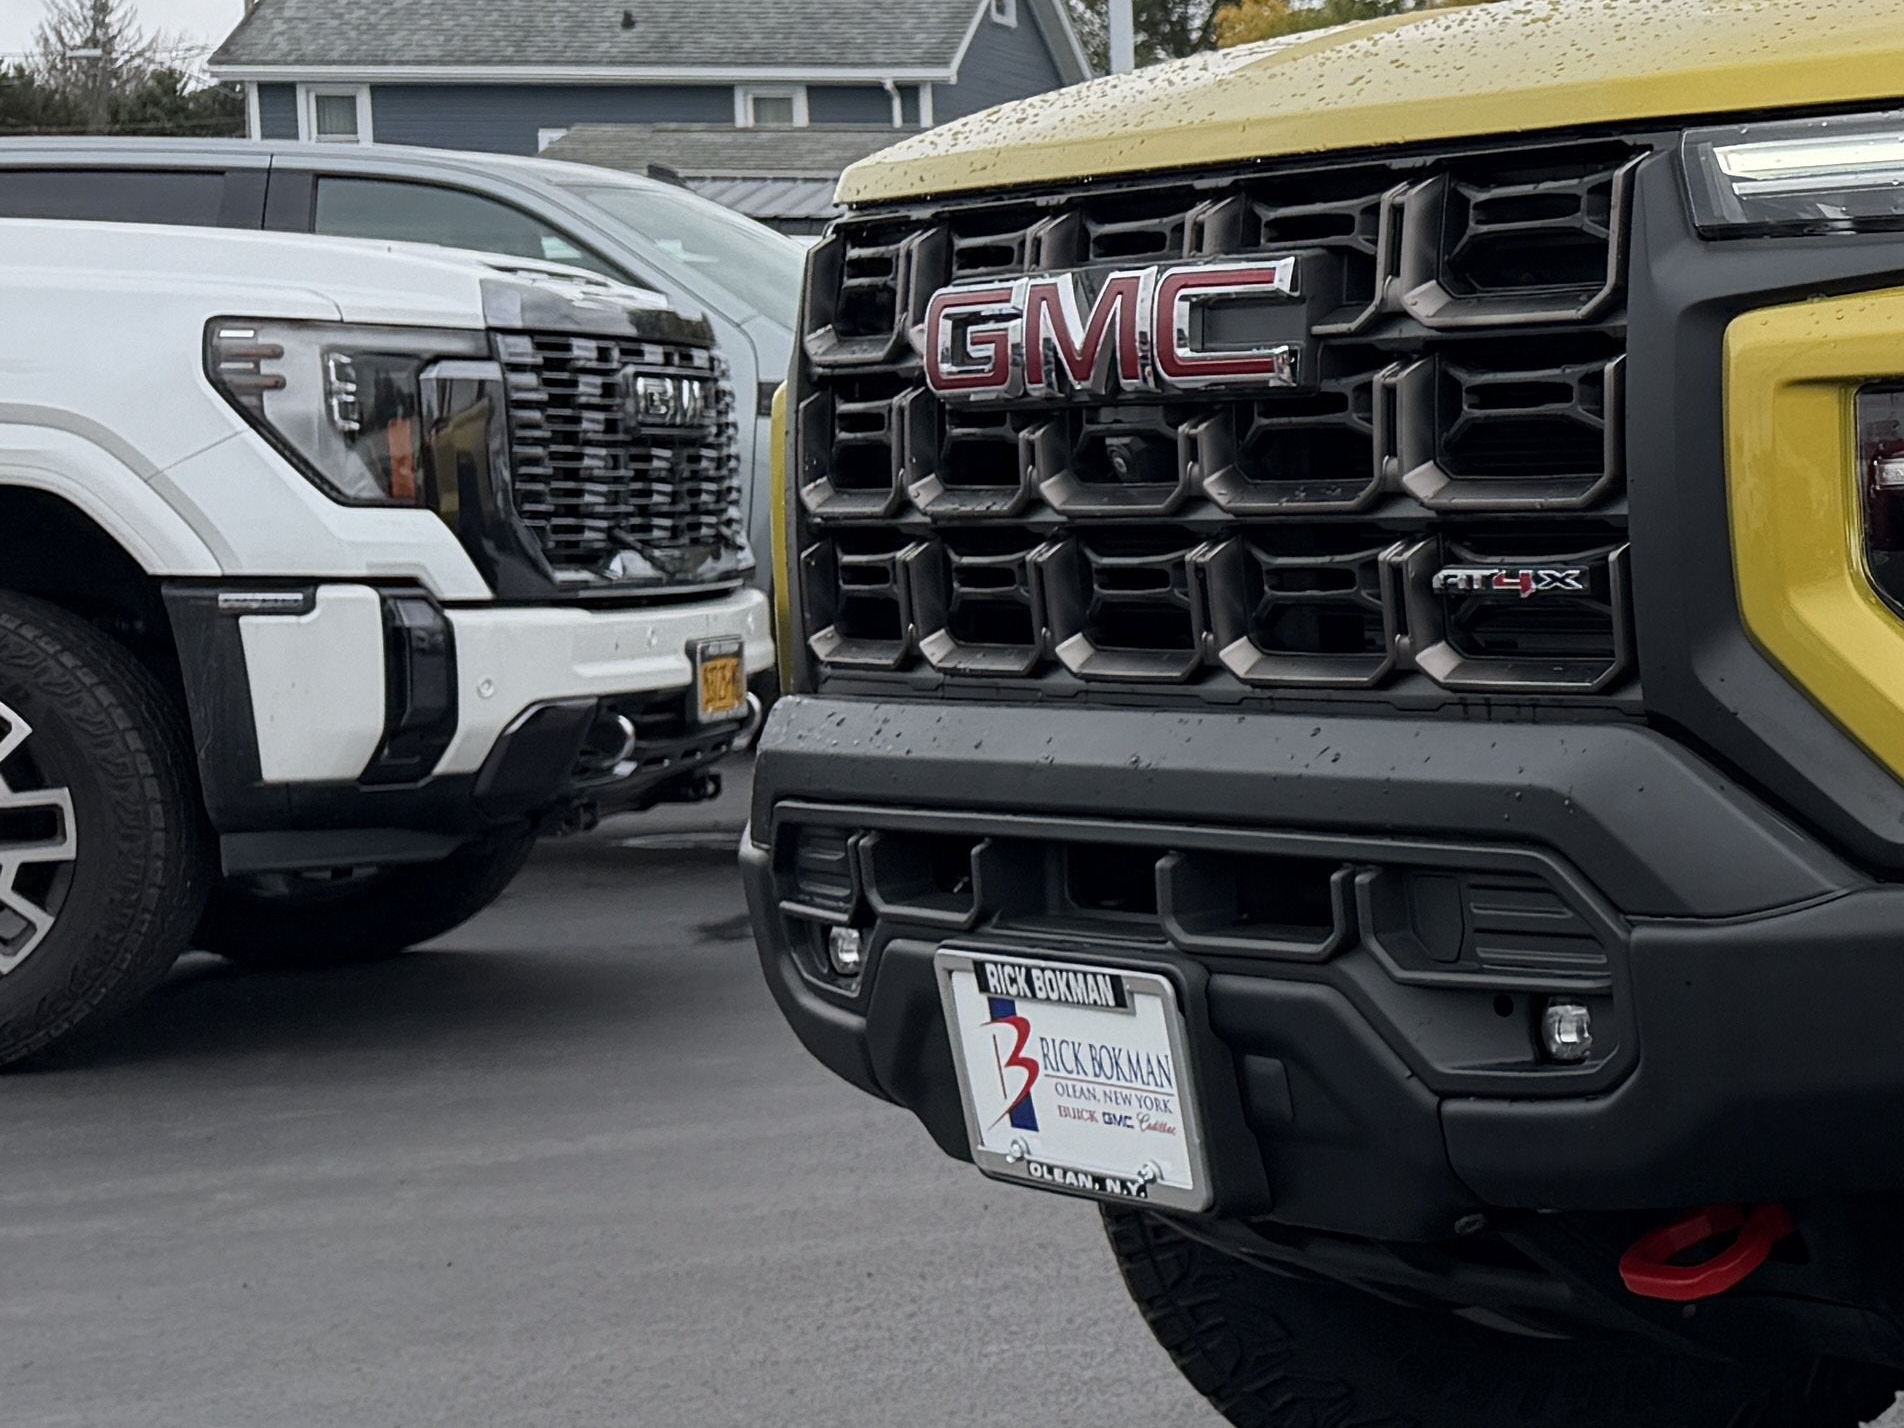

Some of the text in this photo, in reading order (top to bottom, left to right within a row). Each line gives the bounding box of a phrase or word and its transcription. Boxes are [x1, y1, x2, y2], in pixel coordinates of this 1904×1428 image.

[924, 254, 1302, 403] GMC
[1432, 565, 1588, 598] AT4X
[987, 963, 1116, 1007] RICK BOKMAN
[1039, 1036, 1173, 1090] RICK BOKMAN
[1057, 1104, 1099, 1125] BUICK
[1101, 1111, 1136, 1130] GMC
[1103, 1088, 1135, 1108] NEW
[1135, 1092, 1174, 1114] YORK
